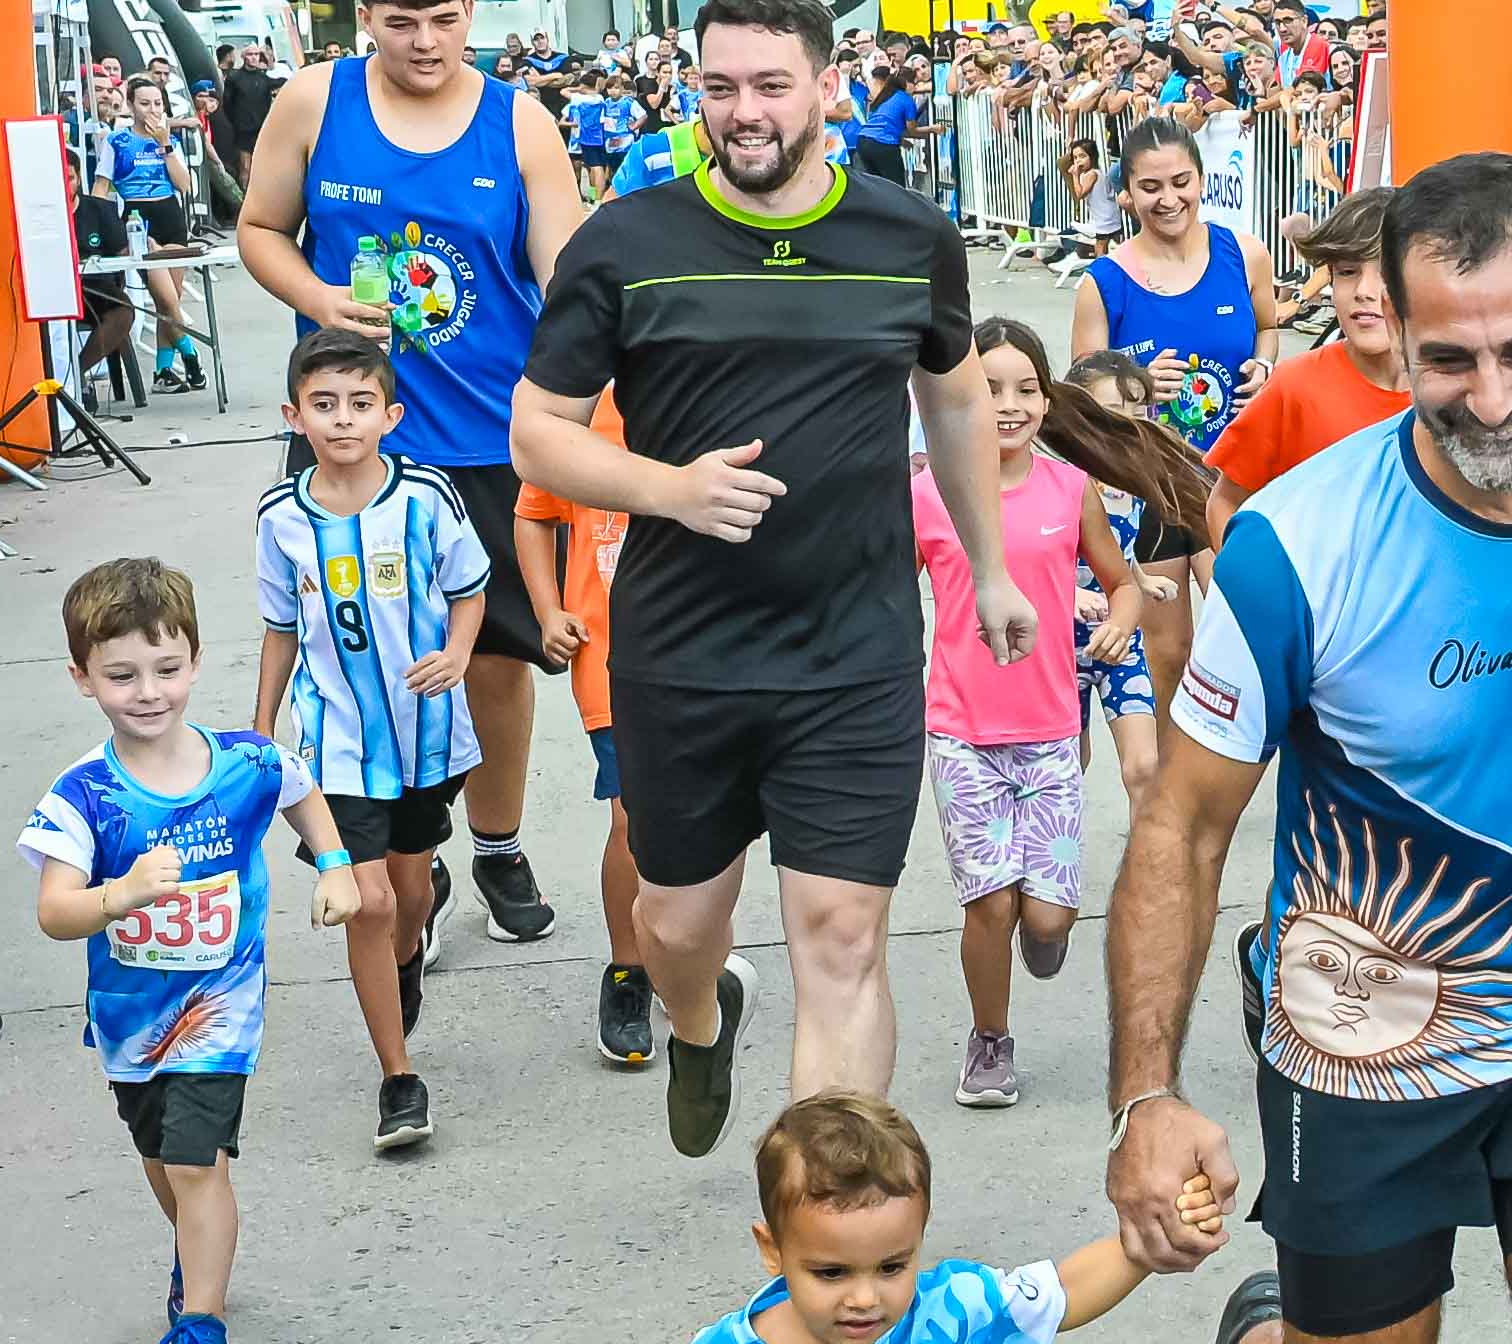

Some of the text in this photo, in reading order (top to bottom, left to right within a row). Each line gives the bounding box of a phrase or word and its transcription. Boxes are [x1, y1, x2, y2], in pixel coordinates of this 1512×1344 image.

[320, 180, 382, 206] PROFE TOMI
[424, 233, 475, 282] CRECER
[428, 288, 477, 348] JUGANDO
[1201, 358, 1233, 388] CRECER
[146, 815, 228, 840] MARATÓN
[210, 827, 227, 839] DE
[181, 837, 234, 865] VINAS
[115, 884, 233, 947] 535
[1292, 1090, 1302, 1184] SALOMON
